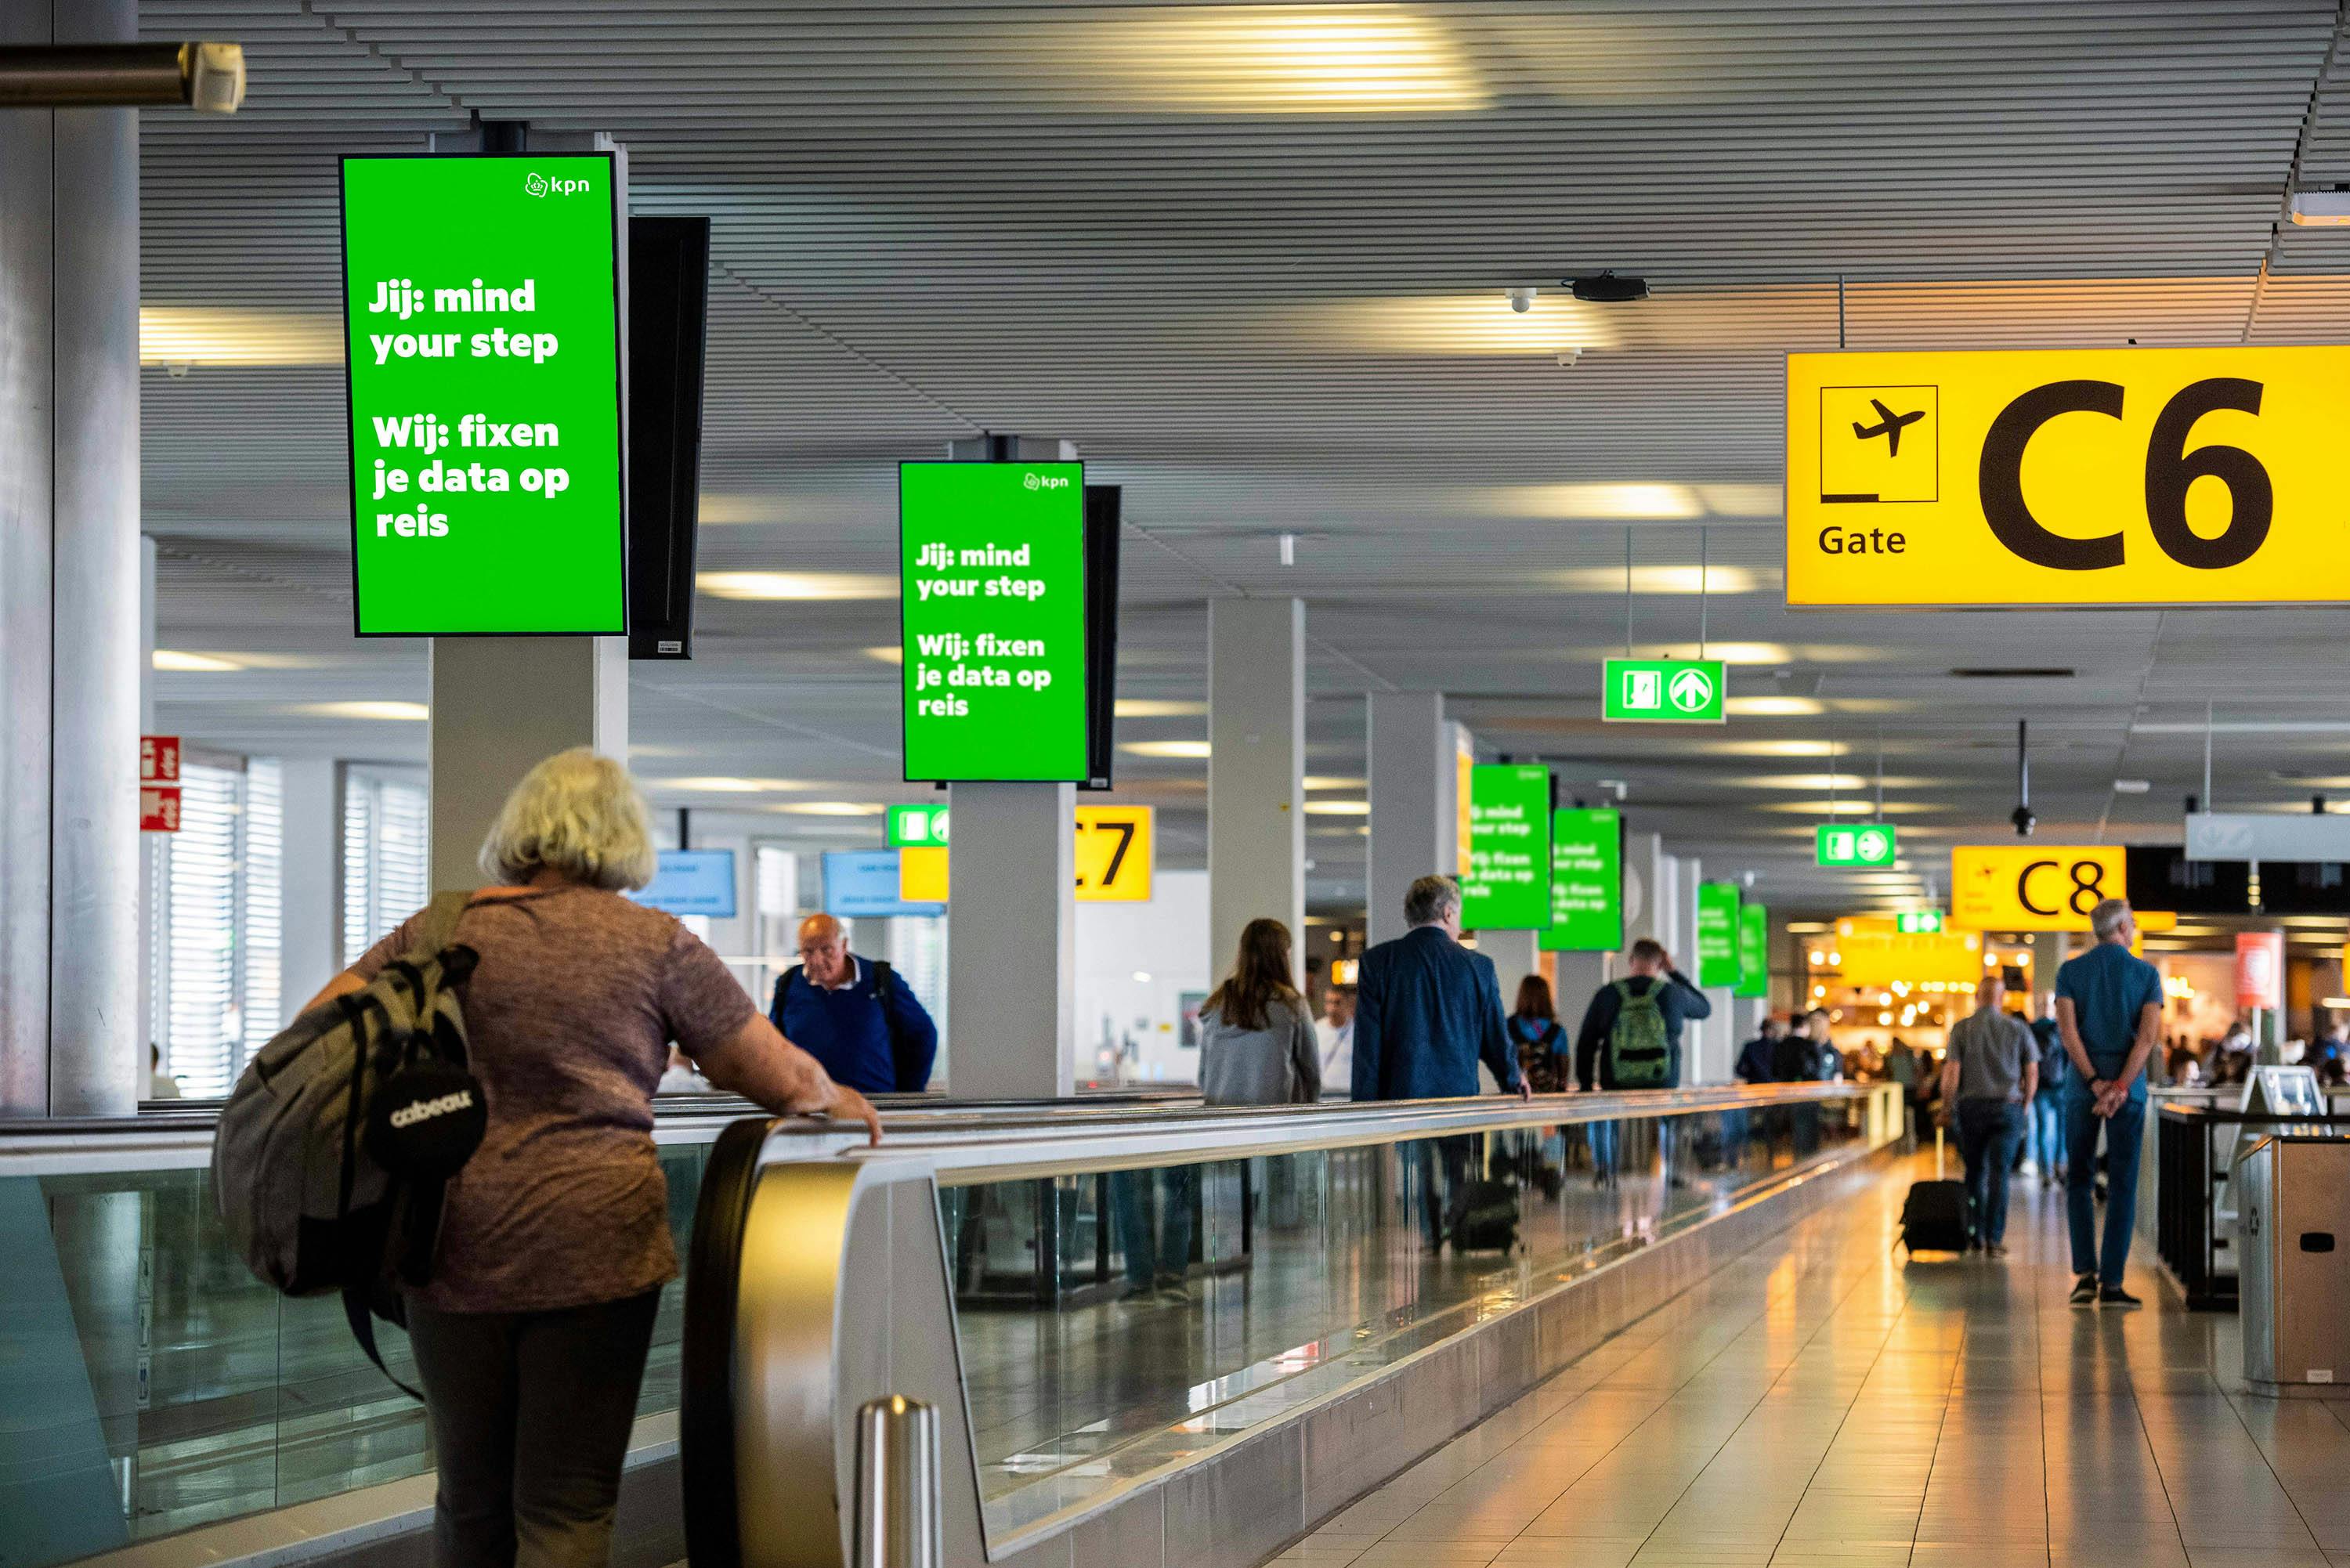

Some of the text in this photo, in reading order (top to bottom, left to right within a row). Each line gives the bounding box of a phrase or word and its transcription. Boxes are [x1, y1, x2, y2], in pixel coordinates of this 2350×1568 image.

[550, 175, 590, 197] kpn
[368, 277, 536, 320] Jij: mind
[369, 327, 559, 365] your step
[371, 413, 559, 455] Wij: fixen
[372, 458, 569, 500] je data op
[1040, 474, 1068, 490] kpn
[1979, 378, 2273, 571] C6
[376, 503, 450, 537] reis
[916, 542, 1030, 571] Jij: mind
[1818, 526, 1906, 555] Gate
[916, 575, 1046, 602] your step
[916, 632, 1045, 661] Wij: fixen
[916, 663, 1052, 692] je data op
[918, 693, 969, 717] reis
[1076, 822, 1134, 886] 7
[2018, 861, 2106, 916] C8
[390, 1089, 473, 1128] cabeau
